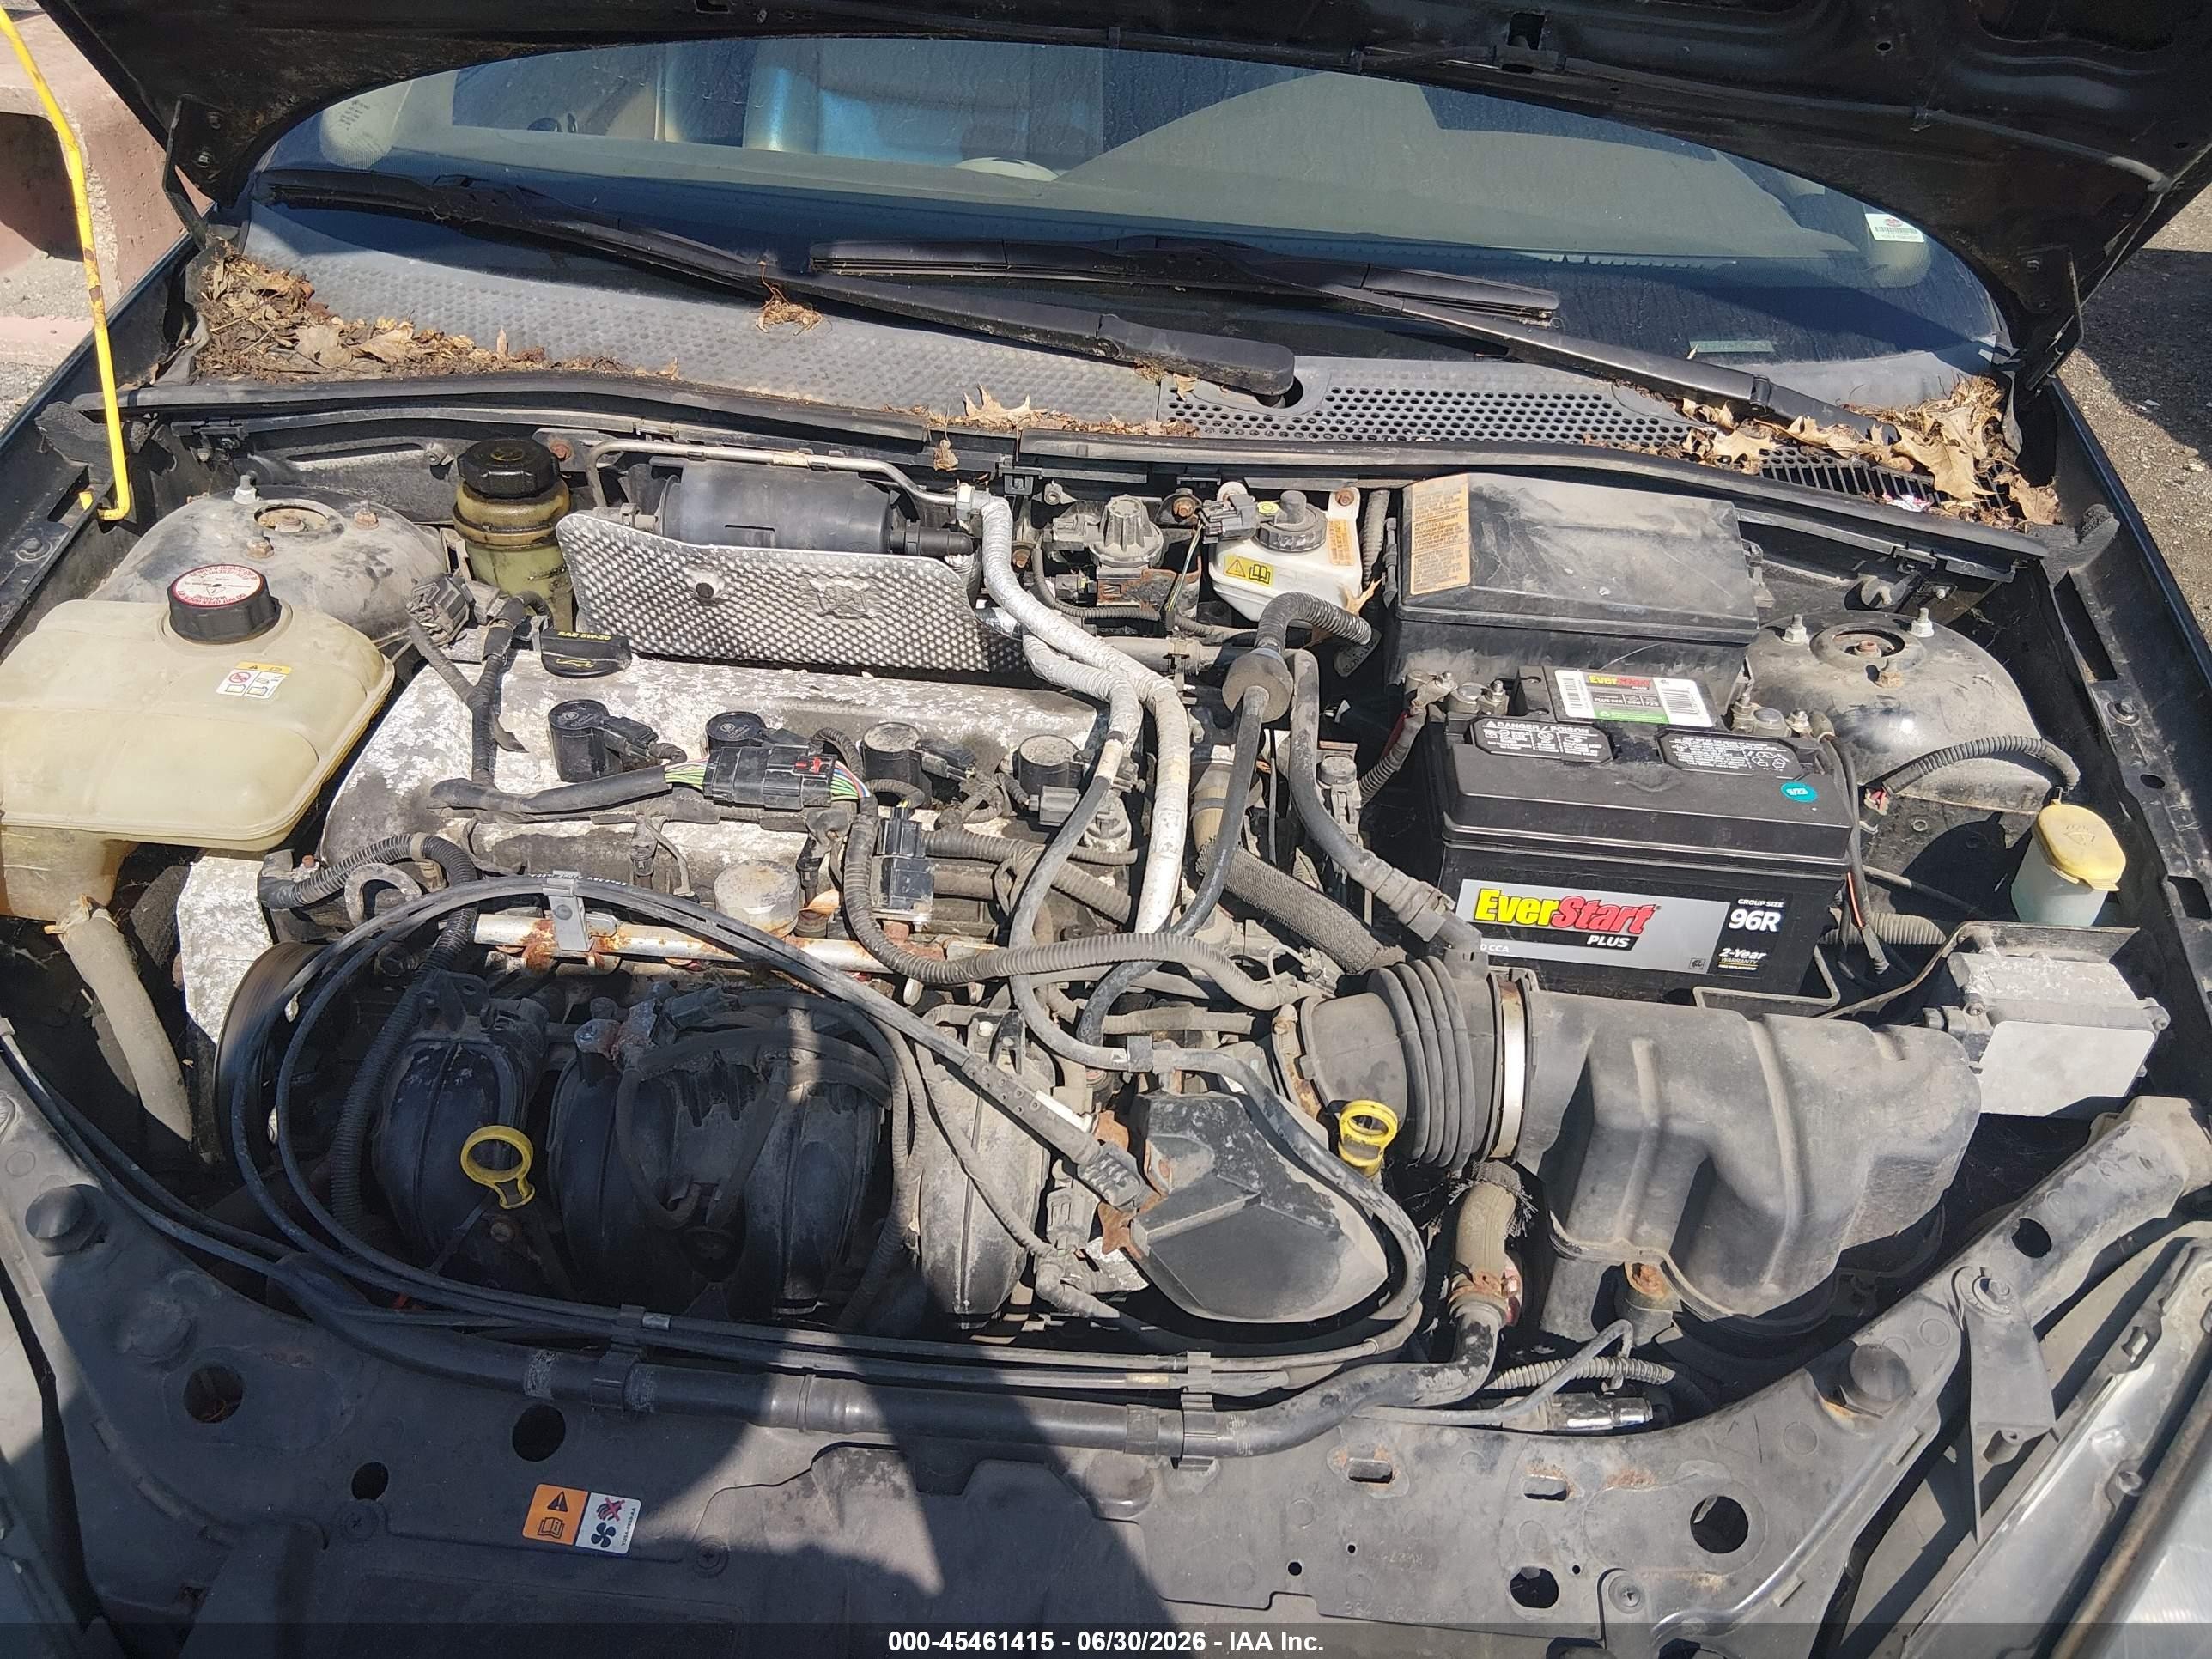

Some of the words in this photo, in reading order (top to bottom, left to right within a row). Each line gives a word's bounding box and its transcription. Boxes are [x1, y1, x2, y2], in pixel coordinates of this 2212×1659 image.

[1497, 721, 1540, 732] DANGER
[1550, 725, 1590, 734] POISON
[1737, 897, 1765, 907] GROUP
[1765, 899, 1784, 908] SIZE
[1474, 889, 1656, 935] EverStart
[1728, 908, 1781, 933] 96R
[1488, 944, 1510, 953] CCA
[1586, 935, 1631, 949] PLUS
[1718, 947, 1767, 960] 2-Year
